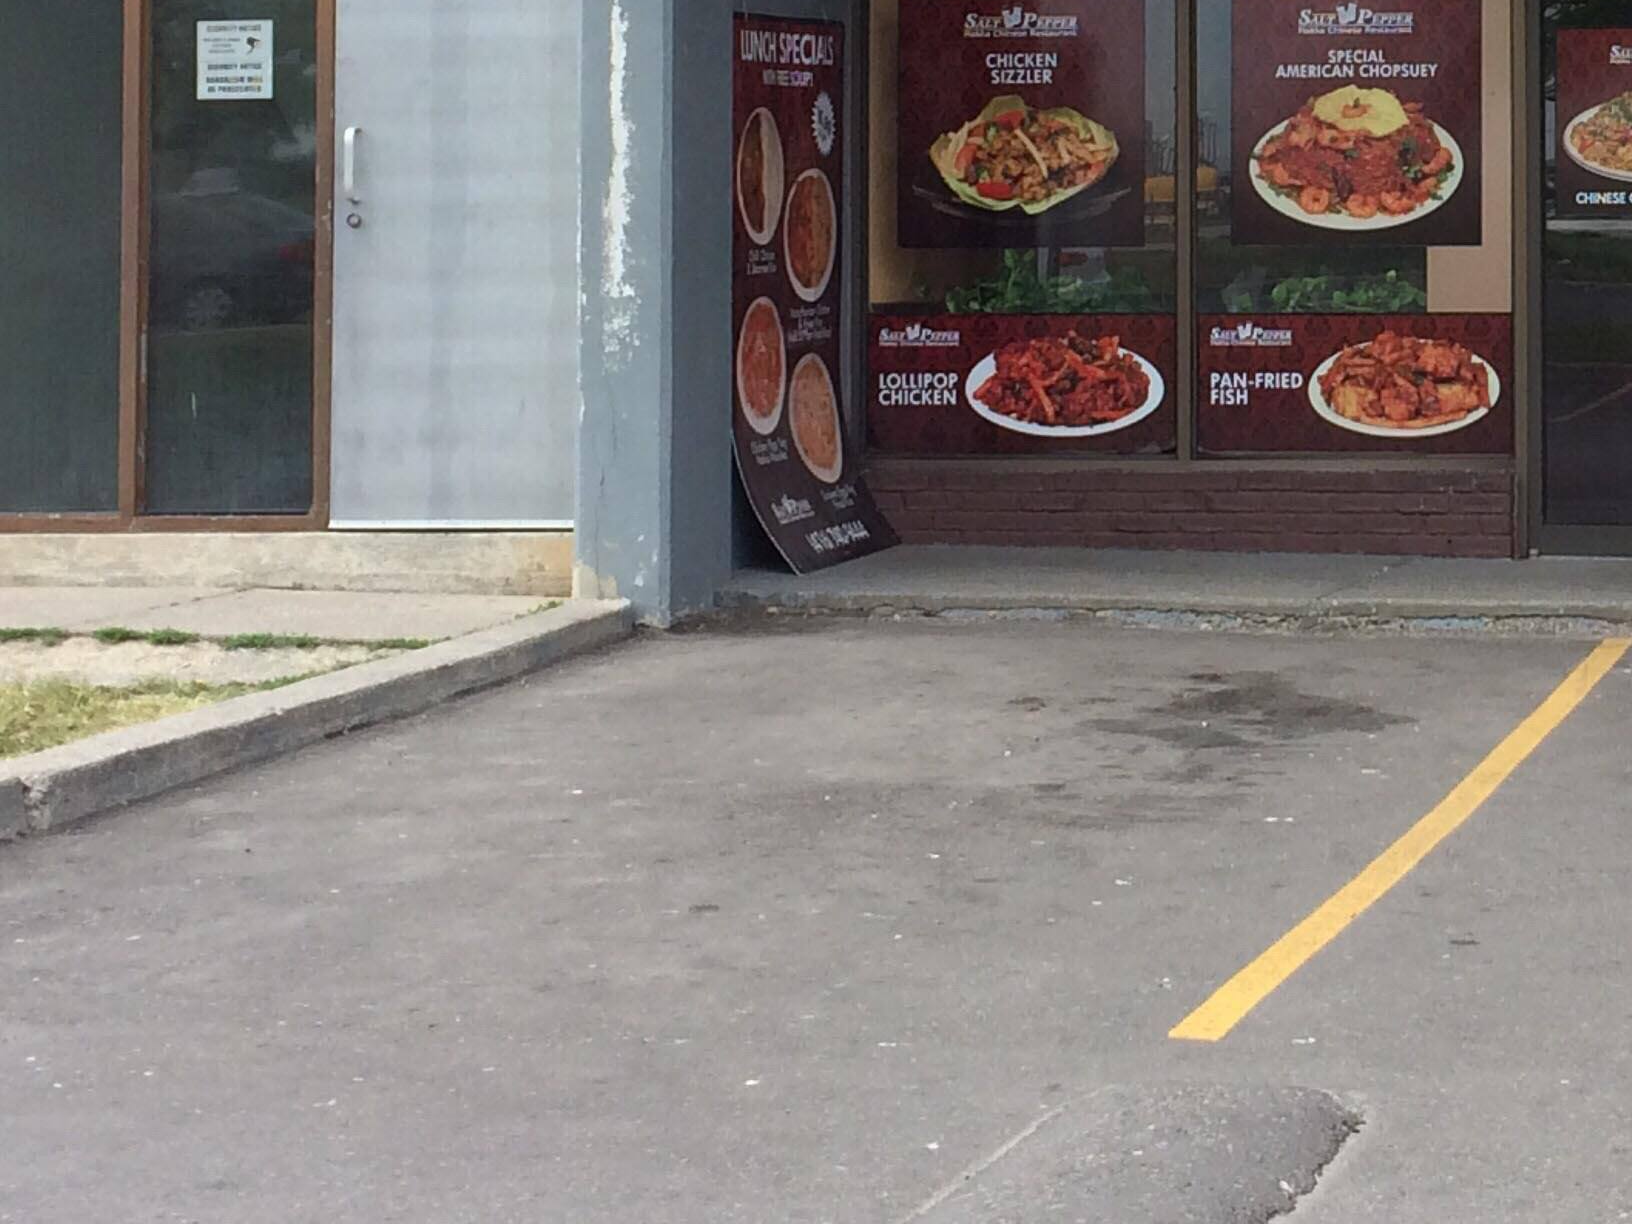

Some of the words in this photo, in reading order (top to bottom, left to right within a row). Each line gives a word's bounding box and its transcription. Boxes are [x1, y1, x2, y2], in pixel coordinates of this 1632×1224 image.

[1358, 8, 1413, 24] PEPPER
[985, 53, 1057, 68] CHICKEN
[1328, 49, 1385, 63] SPECIAL
[991, 69, 1053, 85] SIZZLER
[1275, 64, 1354, 78] AMERICAN
[1359, 63, 1438, 77] CHOPSUEY
[1575, 191, 1626, 204] CHINESE
[879, 372, 959, 389] LOLLIPOP
[1210, 372, 1303, 389] PAN-FRIED
[879, 389, 957, 405] CHICKEN
[1210, 388, 1248, 405] FISH
